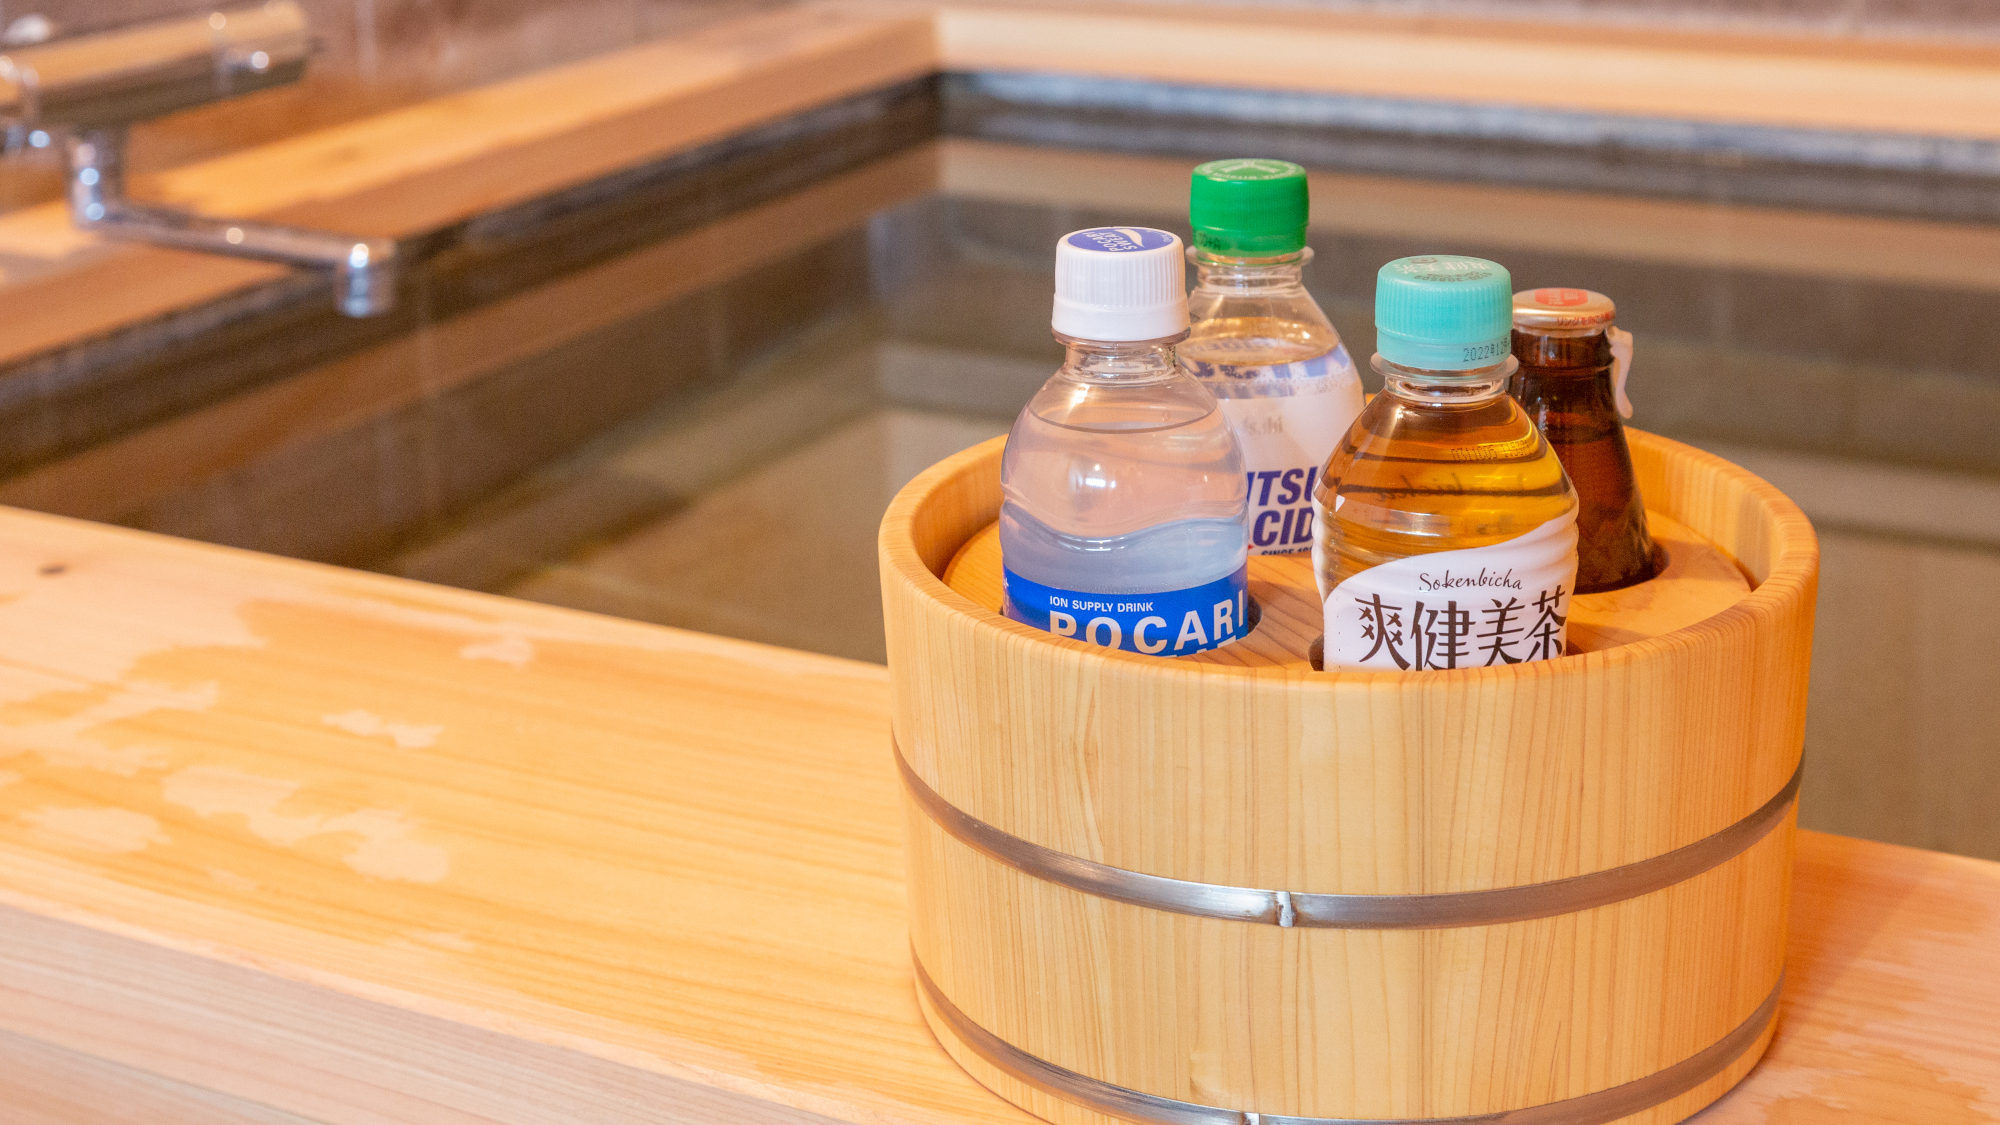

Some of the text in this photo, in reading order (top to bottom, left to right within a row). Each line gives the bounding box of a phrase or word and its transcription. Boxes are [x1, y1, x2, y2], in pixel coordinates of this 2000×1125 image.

[1419, 567, 1523, 592] Sokenbicha
[1050, 595, 1154, 613] ION SUPPLY DRINK
[1050, 589, 1245, 655] POCARI
[1354, 584, 1567, 671] 爽健美茶
